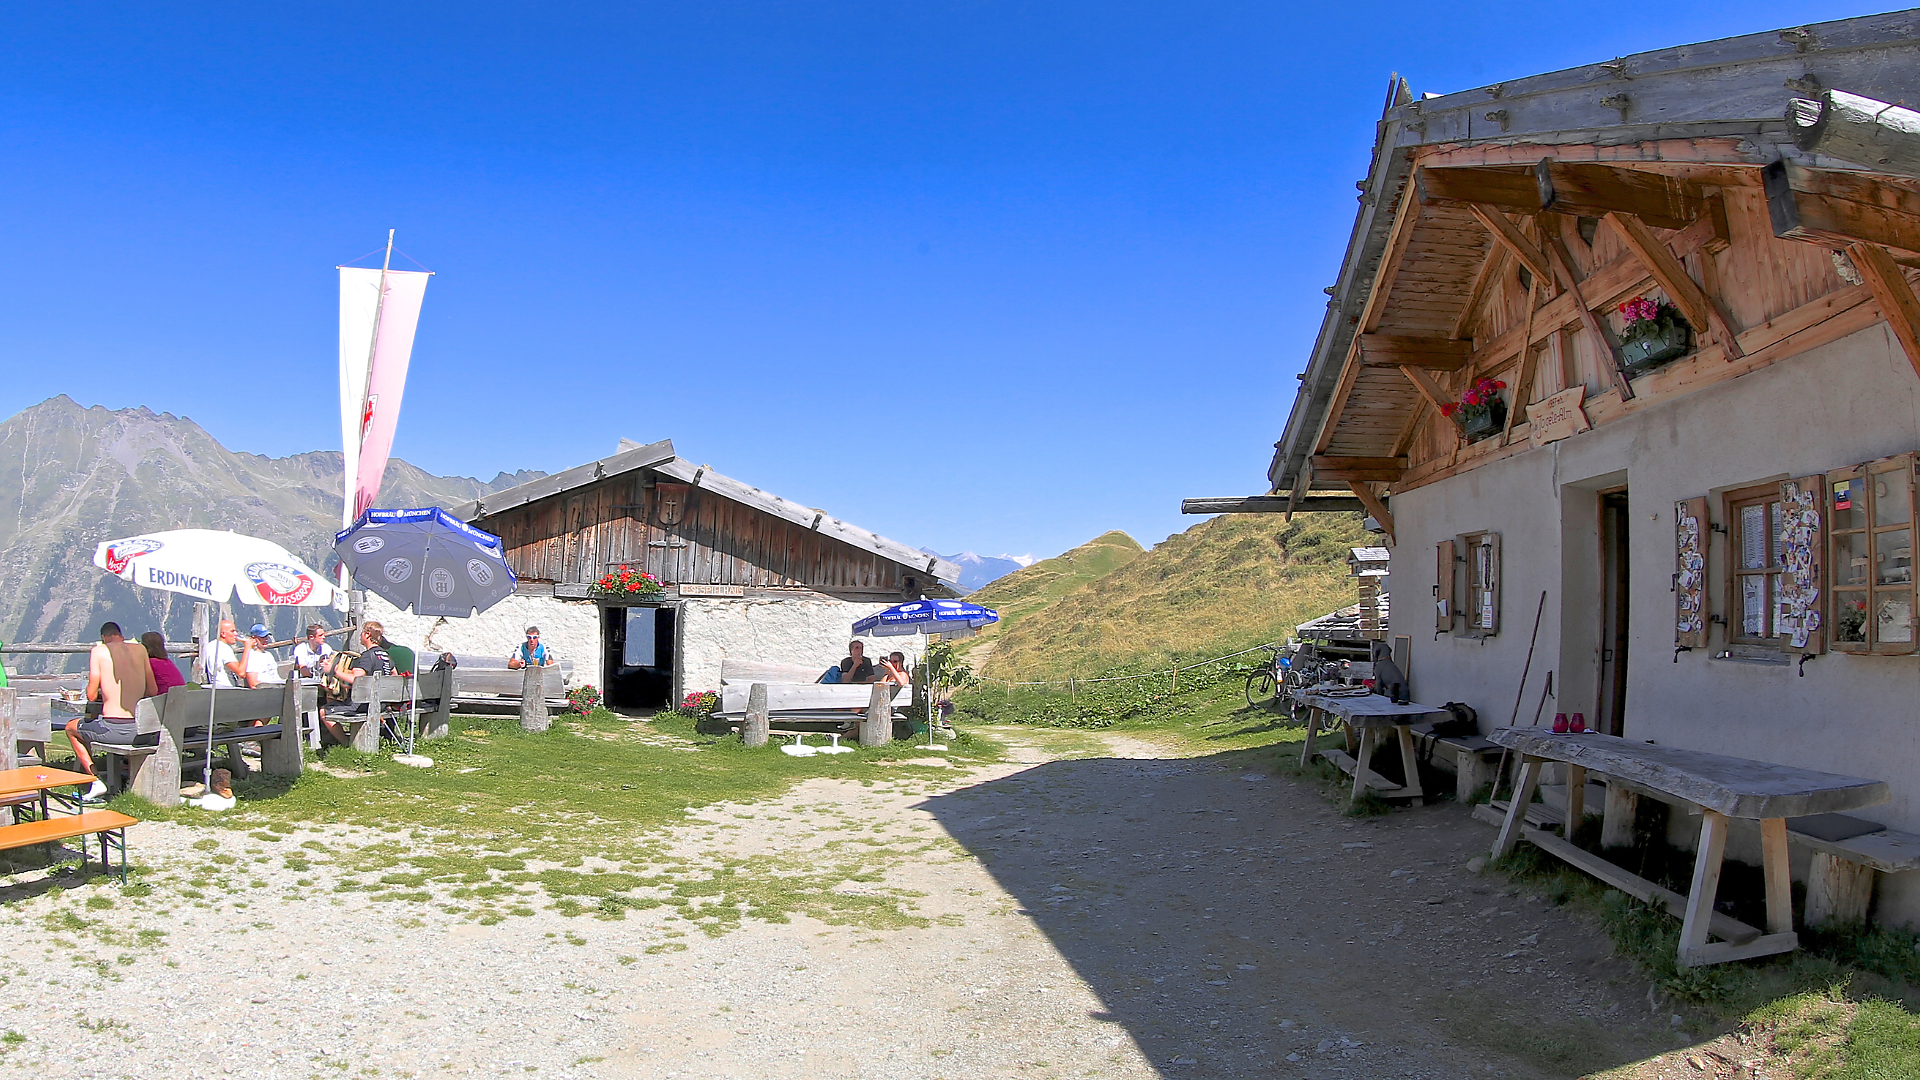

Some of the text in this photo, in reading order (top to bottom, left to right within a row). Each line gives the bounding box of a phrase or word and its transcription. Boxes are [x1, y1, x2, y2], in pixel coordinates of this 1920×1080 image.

[404, 509, 432, 518] MÜNCHEN
[468, 528, 495, 543] MÜNCHEN
[150, 567, 213, 596] ERDINGER
